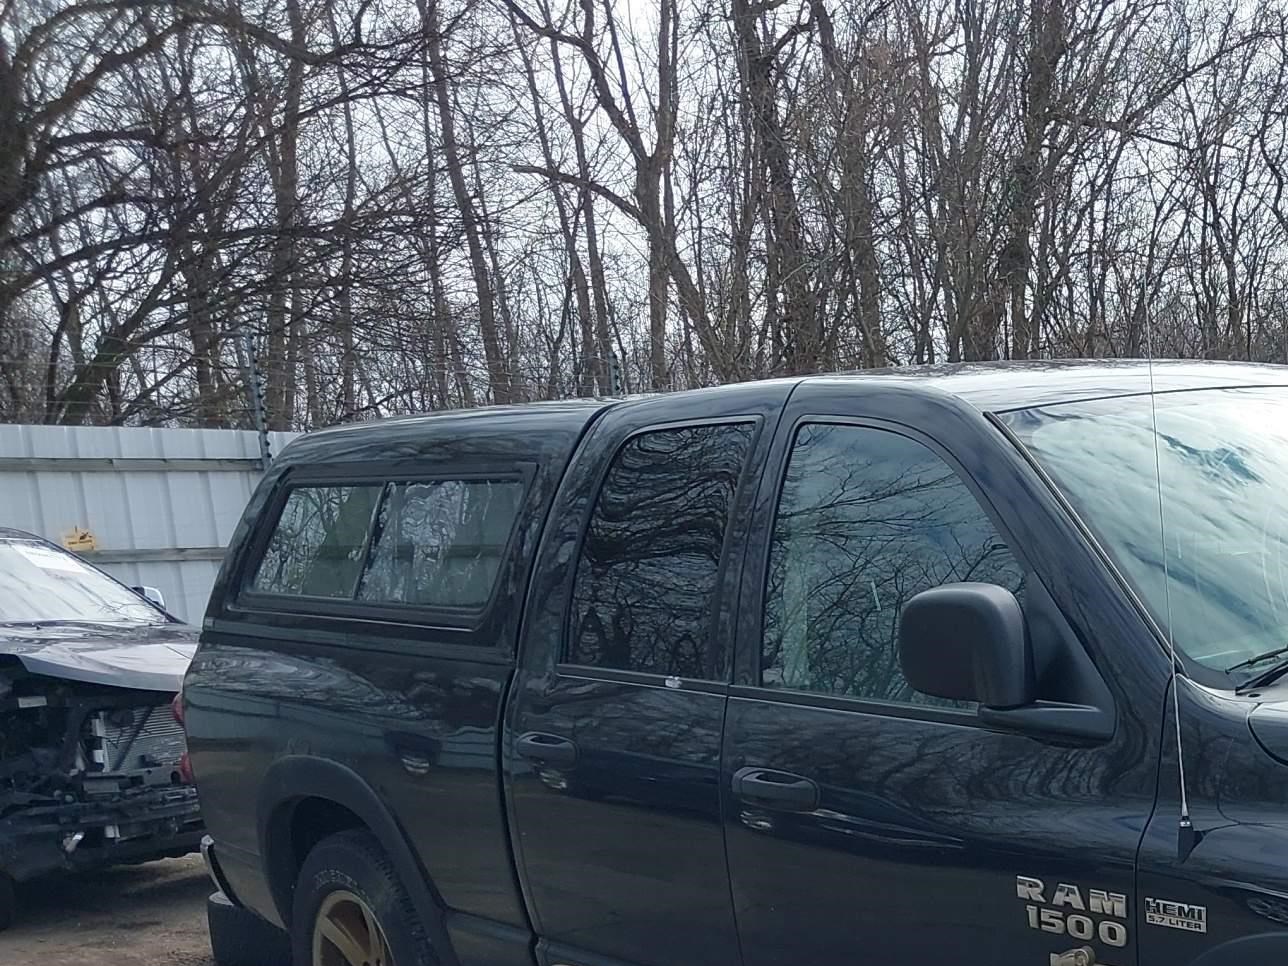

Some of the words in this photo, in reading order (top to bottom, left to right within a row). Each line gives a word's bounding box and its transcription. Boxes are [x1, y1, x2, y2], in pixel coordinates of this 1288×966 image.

[1016, 875, 1128, 919] RAM
[1145, 898, 1205, 921] HEMI
[1026, 905, 1127, 948] 1500
[1147, 914, 1165, 926] 5.7
[1169, 918, 1203, 931] LITER
